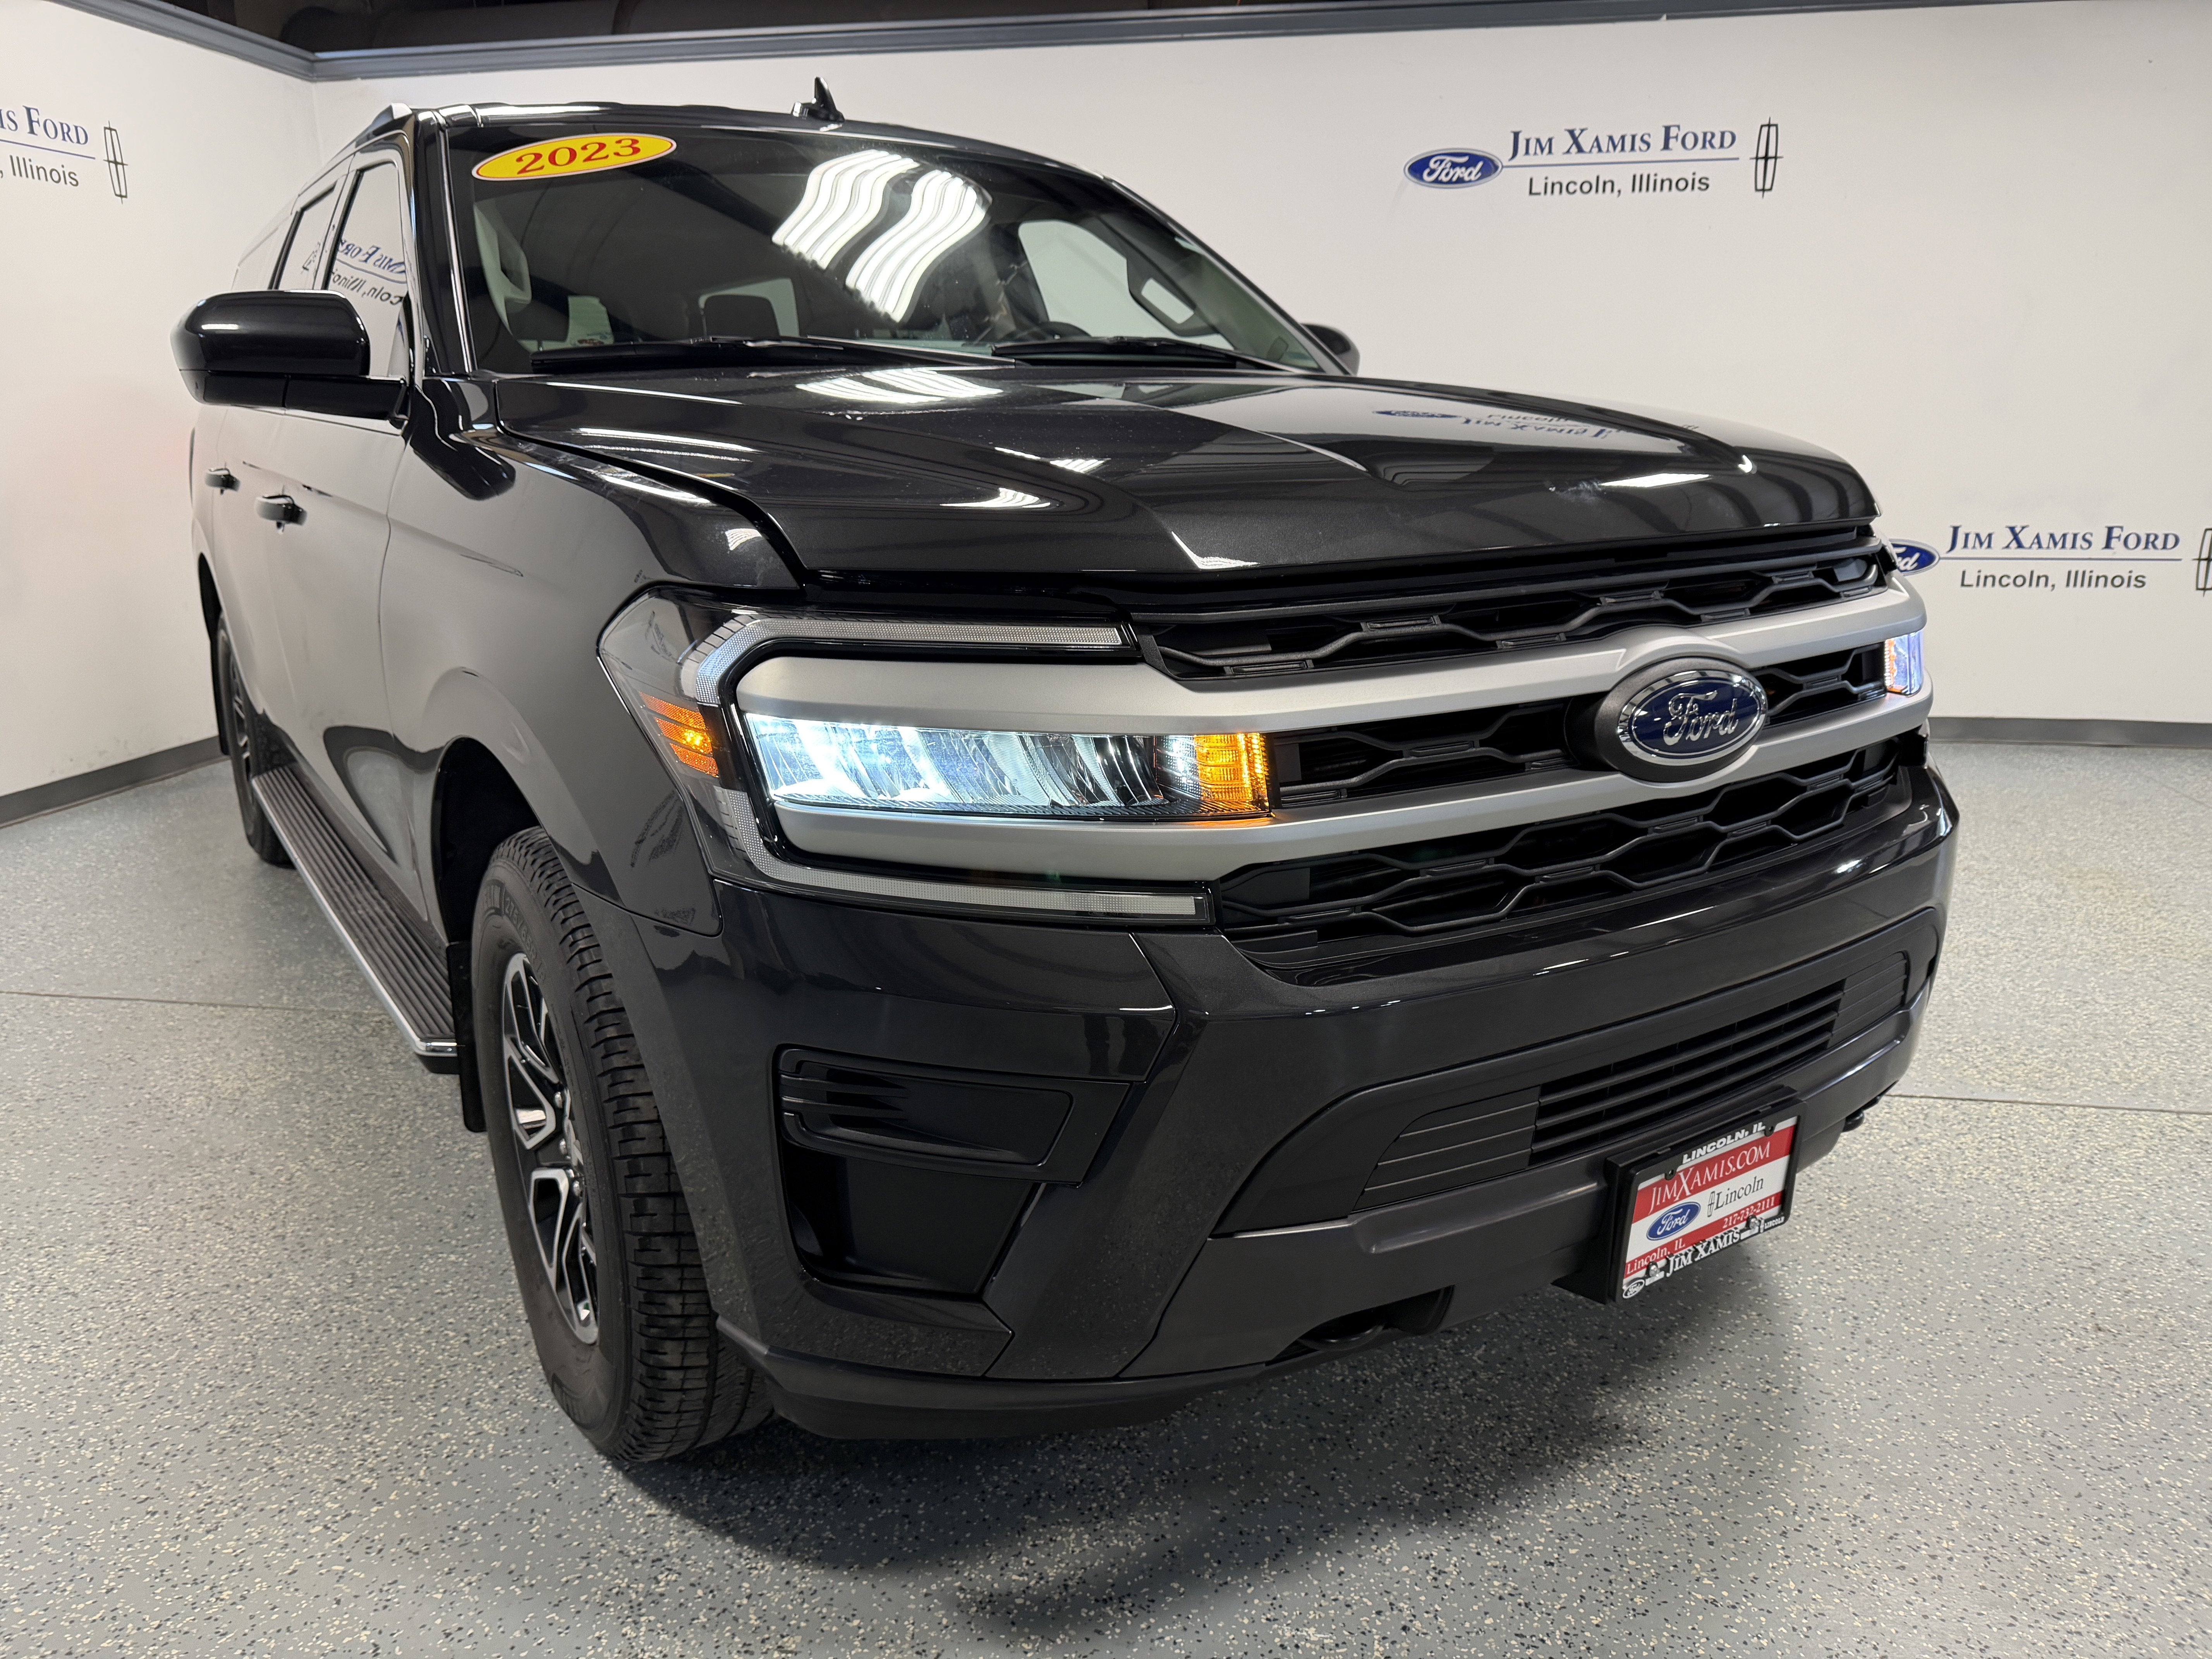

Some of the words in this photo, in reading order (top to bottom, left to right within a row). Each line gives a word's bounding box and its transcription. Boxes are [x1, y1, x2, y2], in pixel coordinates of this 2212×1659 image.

[22, 105, 89, 145] FORD
[515, 138, 641, 175] 2023
[1508, 129, 1554, 162] JIM
[1562, 127, 1652, 155] XAMIS
[1660, 124, 1738, 151] FORD
[9, 155, 79, 187] Illinois
[1422, 155, 1482, 183] Ford
[1528, 172, 1622, 198] Lincoln,
[1632, 172, 1711, 194] Illinois
[1947, 524, 1994, 553] JIM
[2002, 524, 2092, 551] XAMIS
[2100, 525, 2180, 551] FORD
[1960, 570, 2057, 592] Lincoln,
[2066, 570, 2147, 589] Illinois
[1663, 690, 1740, 746] Ford
[1682, 1129, 1749, 1164] LINCOLN,
[1752, 1121, 1766, 1134] IL
[1714, 1176, 1764, 1211] Lincoln
[1656, 1208, 1691, 1236] Ford
[1722, 1196, 1775, 1229] 217-732-2111
[1666, 1246, 1693, 1277] JIM
[1693, 1228, 1740, 1262] XAMIS
[1674, 1238, 1686, 1251] IL
